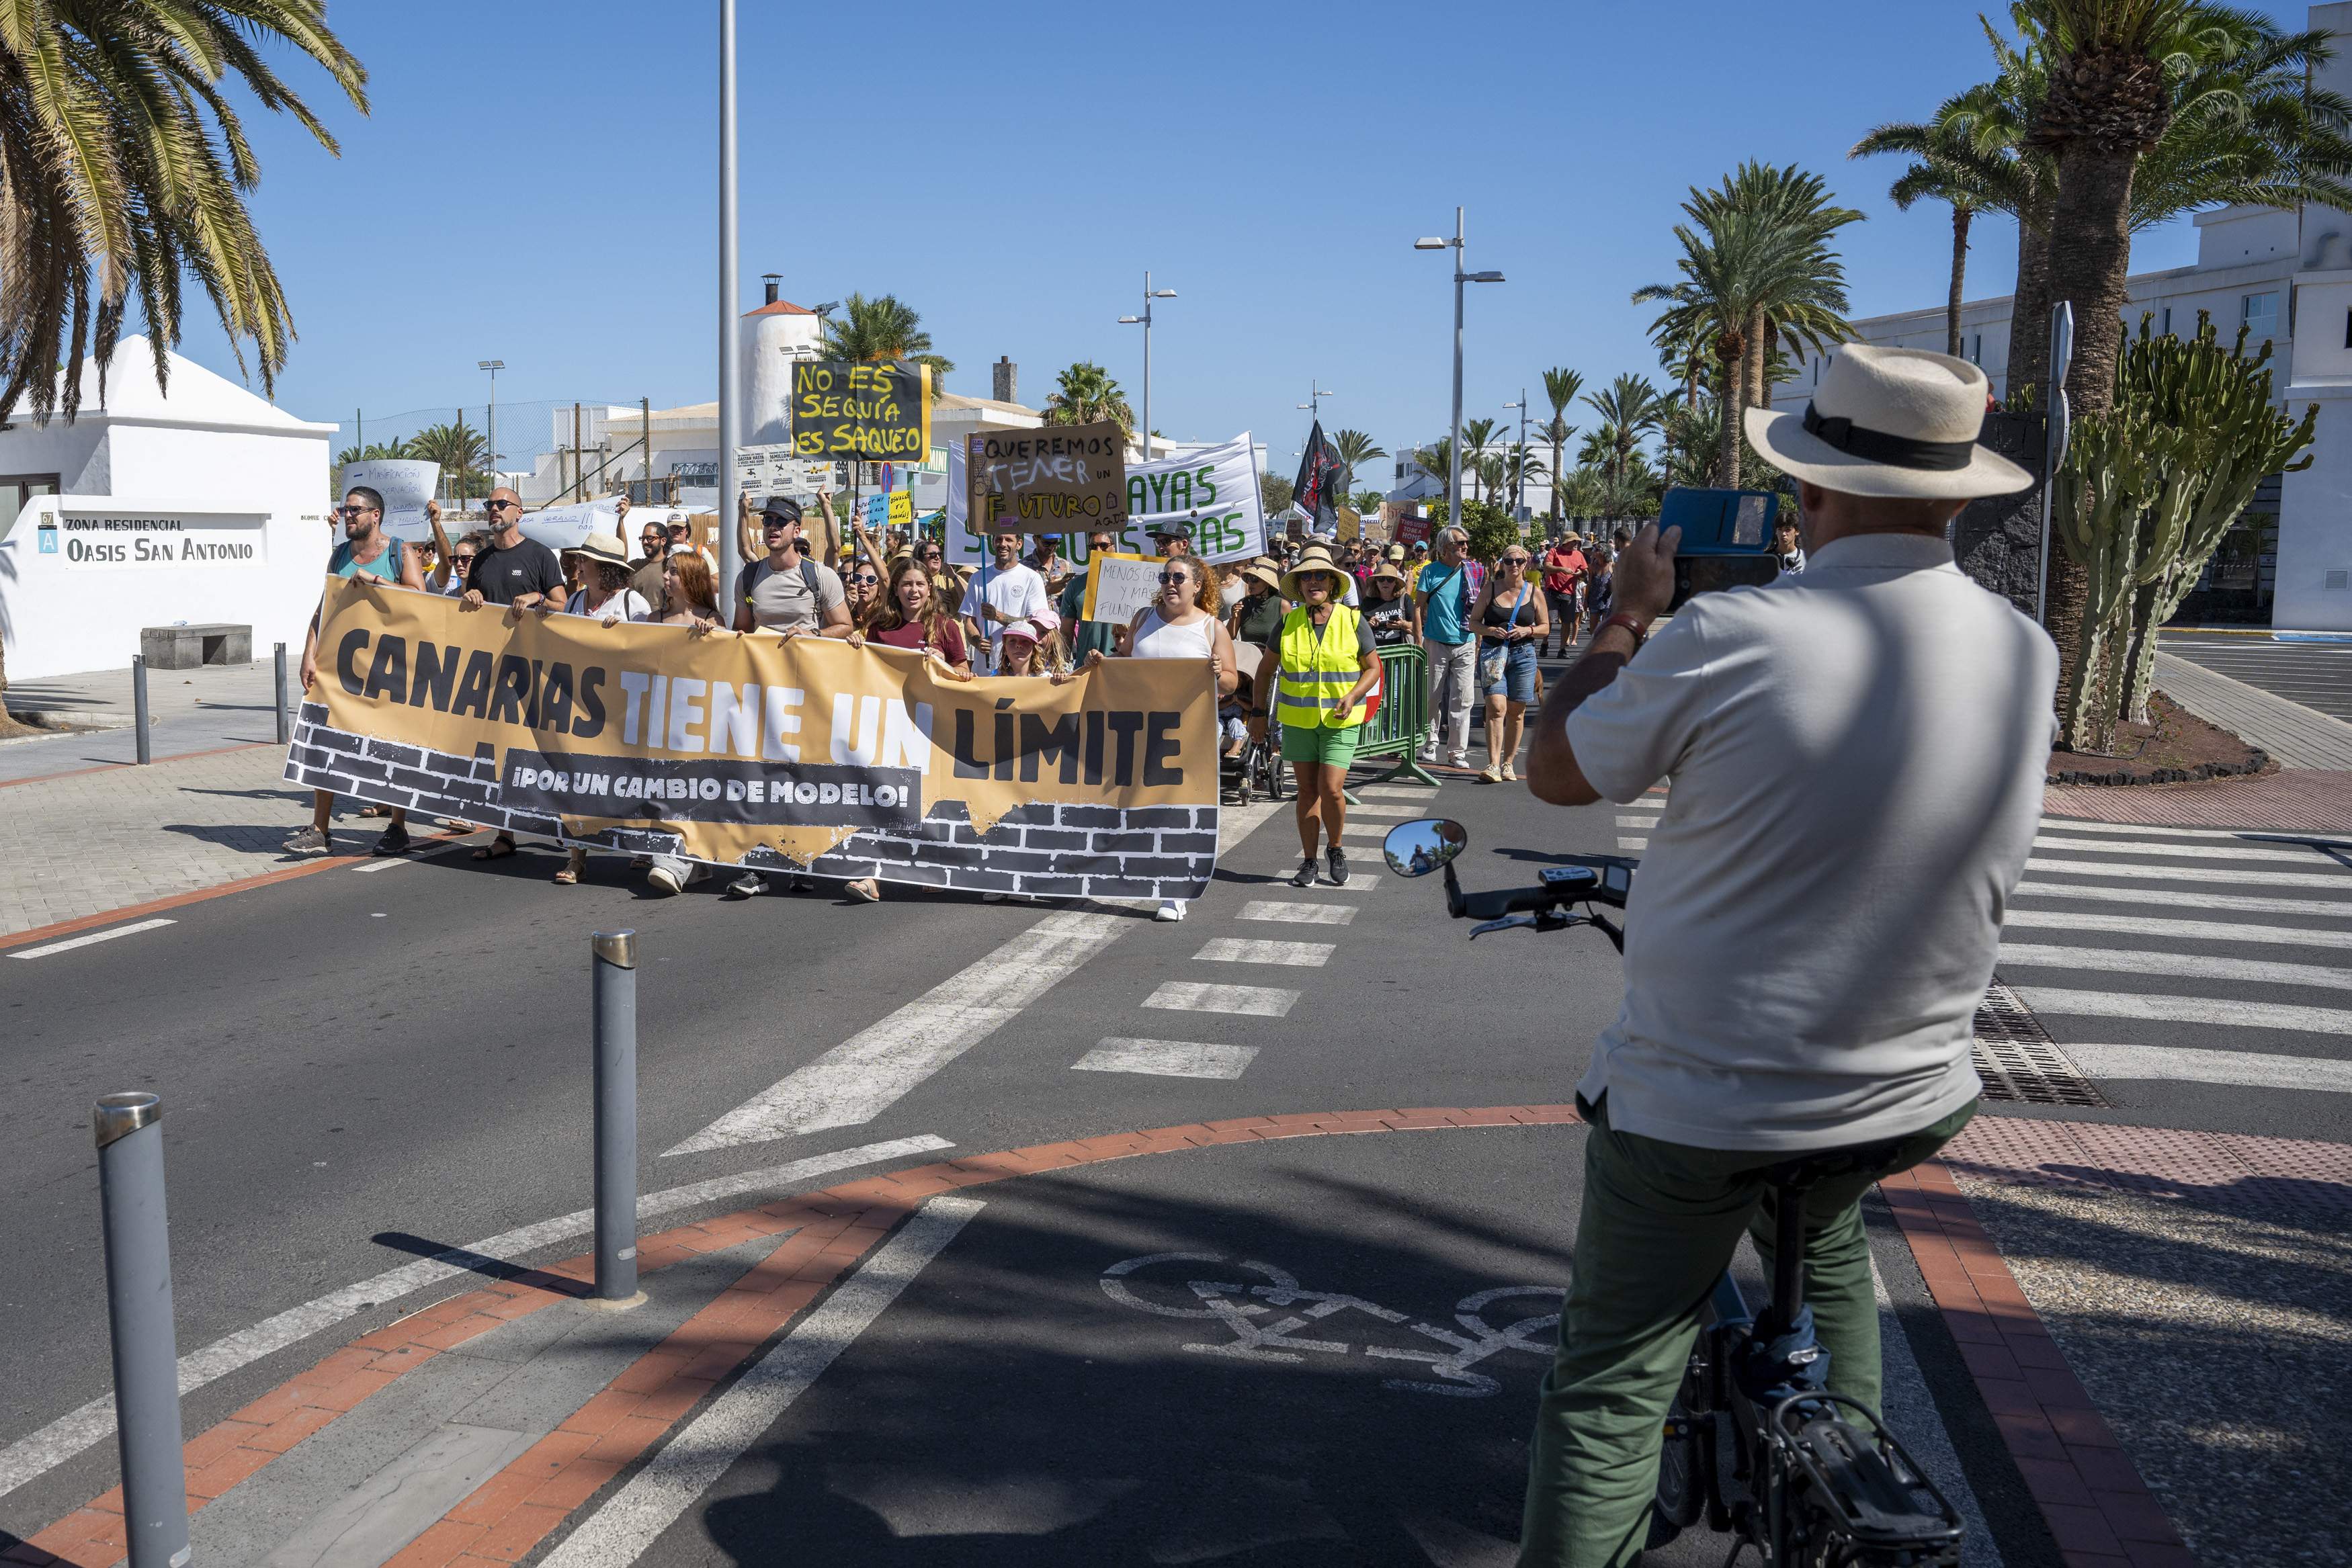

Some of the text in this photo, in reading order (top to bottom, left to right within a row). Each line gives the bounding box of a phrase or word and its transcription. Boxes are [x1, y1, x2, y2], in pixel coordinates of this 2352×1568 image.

[798, 365, 896, 394] NO ES
[799, 394, 900, 423] SEQUÍA
[796, 424, 920, 454] ES SAQUEO
[984, 437, 1114, 459] QUEREMOS
[988, 455, 1091, 492] TENER
[1096, 469, 1111, 480] UN
[1127, 465, 1217, 515] AYAS
[42, 513, 52, 523] 67
[65, 519, 184, 531] ZONA RESIDENCIAL
[1400, 519, 1428, 529] THIS USED
[43, 533, 54, 550] A
[1103, 564, 1141, 582] MENOS
[1120, 585, 1128, 601] Y
[337, 628, 1184, 787] CANARIAS TIENE UN LÍMITE
[511, 766, 909, 808] ¡POR UN CAMBIO DE MODELO!
